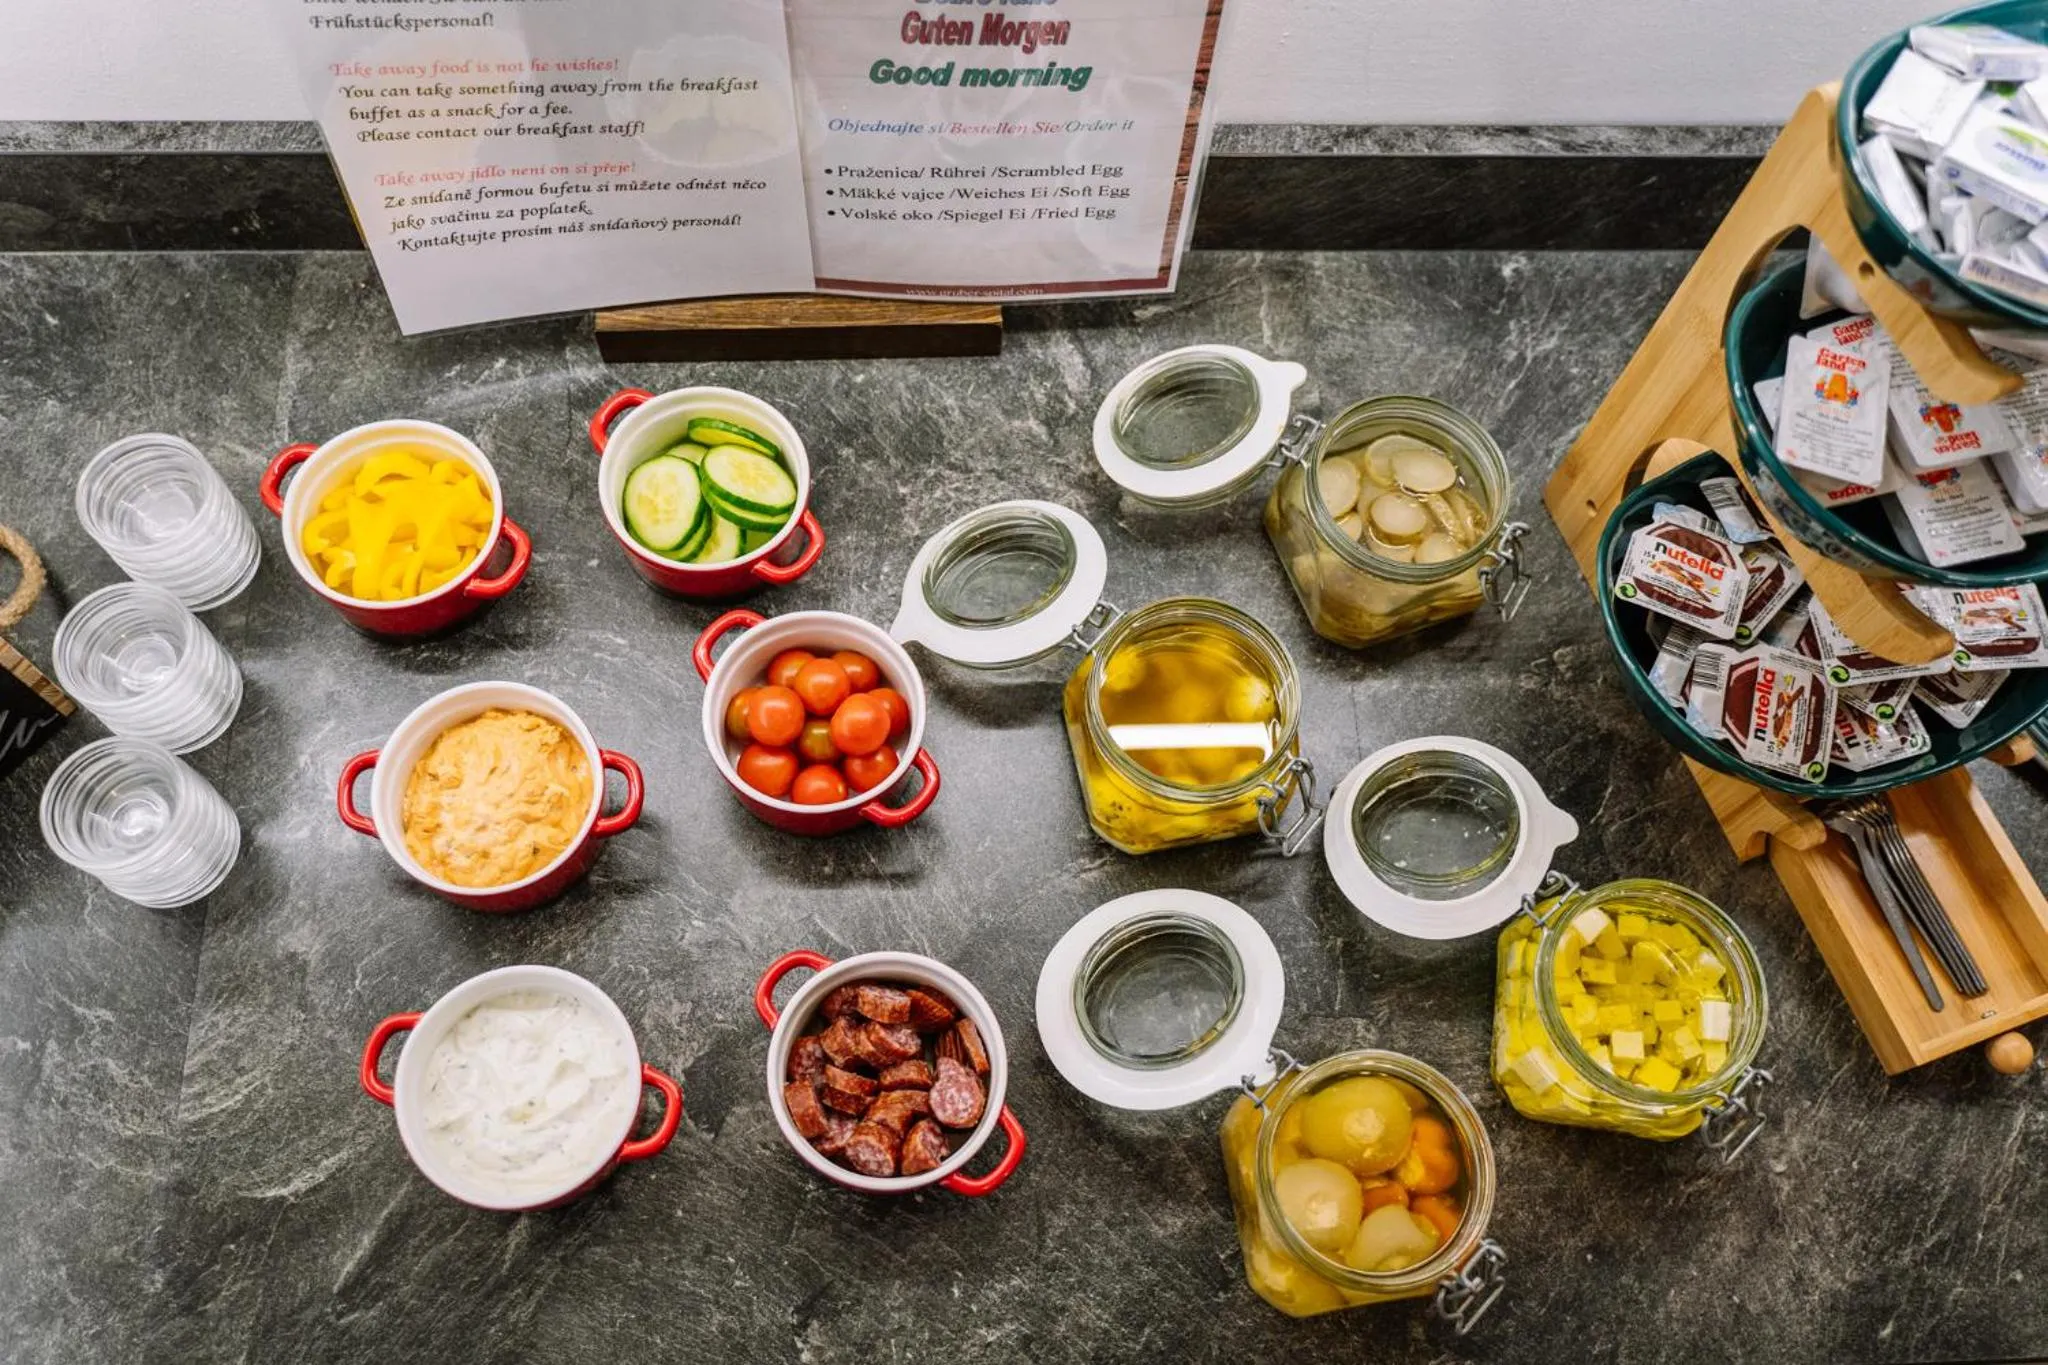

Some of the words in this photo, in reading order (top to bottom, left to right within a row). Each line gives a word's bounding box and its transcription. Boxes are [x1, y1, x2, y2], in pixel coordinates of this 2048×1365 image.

[309, 12, 494, 32] Frühstückspersonal!
[901, 10, 974, 46] Guten
[978, 12, 1071, 54] Morgen
[329, 62, 372, 78] Take
[378, 65, 426, 78] away
[430, 59, 470, 77] food
[476, 61, 490, 74] is
[496, 62, 523, 73] not
[555, 58, 619, 72] wishes!
[869, 58, 955, 87] Good
[960, 61, 1093, 92] morning
[338, 85, 375, 99] You
[380, 87, 410, 98] can
[416, 83, 453, 99] take
[458, 81, 545, 97] something
[550, 82, 598, 97] away
[600, 80, 642, 96] from
[649, 79, 674, 92] the
[681, 78, 759, 95] breakfast
[350, 107, 401, 122] buffet
[408, 109, 425, 118] as
[430, 109, 441, 118] a
[447, 103, 499, 120] snack
[498, 102, 523, 118] for
[529, 105, 539, 115] a
[542, 103, 573, 117] fee.
[357, 128, 411, 143] Please
[416, 128, 477, 140] contact
[483, 126, 512, 137] our
[516, 122, 593, 138] breakfast
[599, 121, 646, 138] staff!
[828, 118, 924, 136] Objednajte
[1121, 119, 1135, 132] it
[374, 171, 415, 187] Take
[419, 169, 465, 184] away
[550, 165, 569, 175] on
[592, 160, 637, 177] přeje!
[838, 165, 925, 180] Praženica/
[930, 165, 986, 179] Rührei
[991, 163, 1085, 179] /Scrambled
[1091, 164, 1123, 179] Egg
[384, 195, 406, 209] Ze
[411, 189, 472, 206] snídaně
[475, 185, 534, 204] formou
[539, 181, 591, 199] bufetu
[614, 178, 671, 192] můžete
[676, 177, 727, 191] odnést
[732, 178, 767, 190] něco
[838, 185, 896, 200] Mäkké
[901, 187, 945, 203] vajce
[949, 187, 1026, 200] /Weiches
[1031, 186, 1048, 198] Ei
[1053, 185, 1093, 199] /Soft
[1099, 185, 1131, 200] Egg
[391, 215, 425, 233] jako
[430, 208, 490, 225] svačinu
[496, 208, 515, 219] za
[840, 206, 897, 221] Volské
[902, 207, 933, 221] oko
[937, 206, 1003, 223] /Spiegel
[1009, 207, 1026, 220] Ei
[1031, 206, 1079, 220] /Fried
[1084, 206, 1116, 220] Egg
[397, 231, 496, 252] Kontaktujte
[501, 224, 552, 242] prosím
[557, 221, 585, 234] náš
[589, 216, 668, 232] snídaňový
[672, 213, 742, 231] personál!
[1832, 318, 1874, 337] Garten
[1818, 347, 1866, 369] Garten
[1654, 541, 1725, 581] nutella
[1953, 587, 2021, 605] nutella
[1753, 667, 1777, 742] nutella
